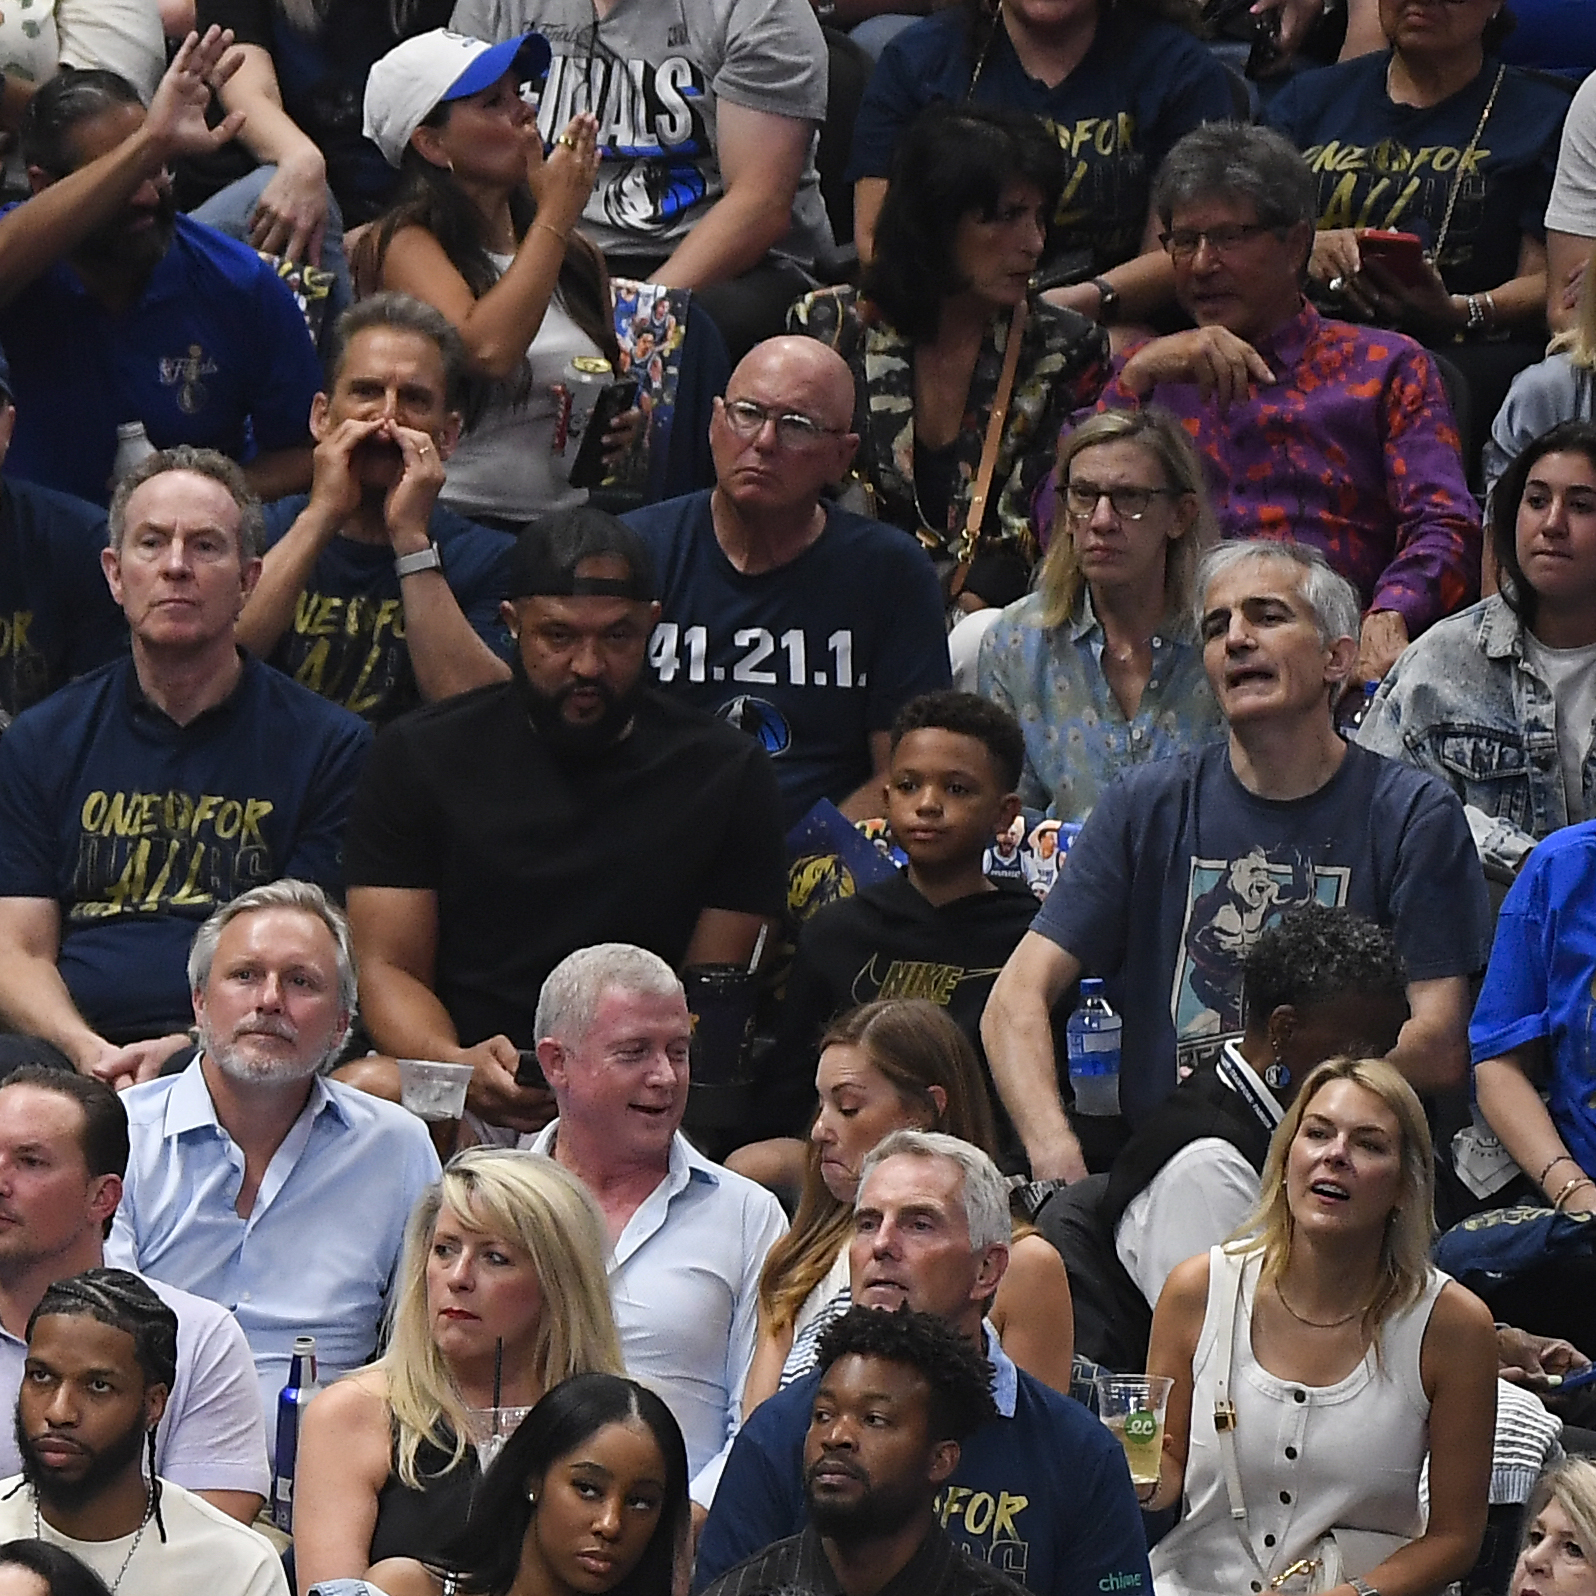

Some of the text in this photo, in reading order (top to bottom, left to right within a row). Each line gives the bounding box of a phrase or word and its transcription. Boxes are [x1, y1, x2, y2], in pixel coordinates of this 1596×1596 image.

[82, 789, 275, 849] ONE FOR
[942, 1486, 1028, 1541] FOR
